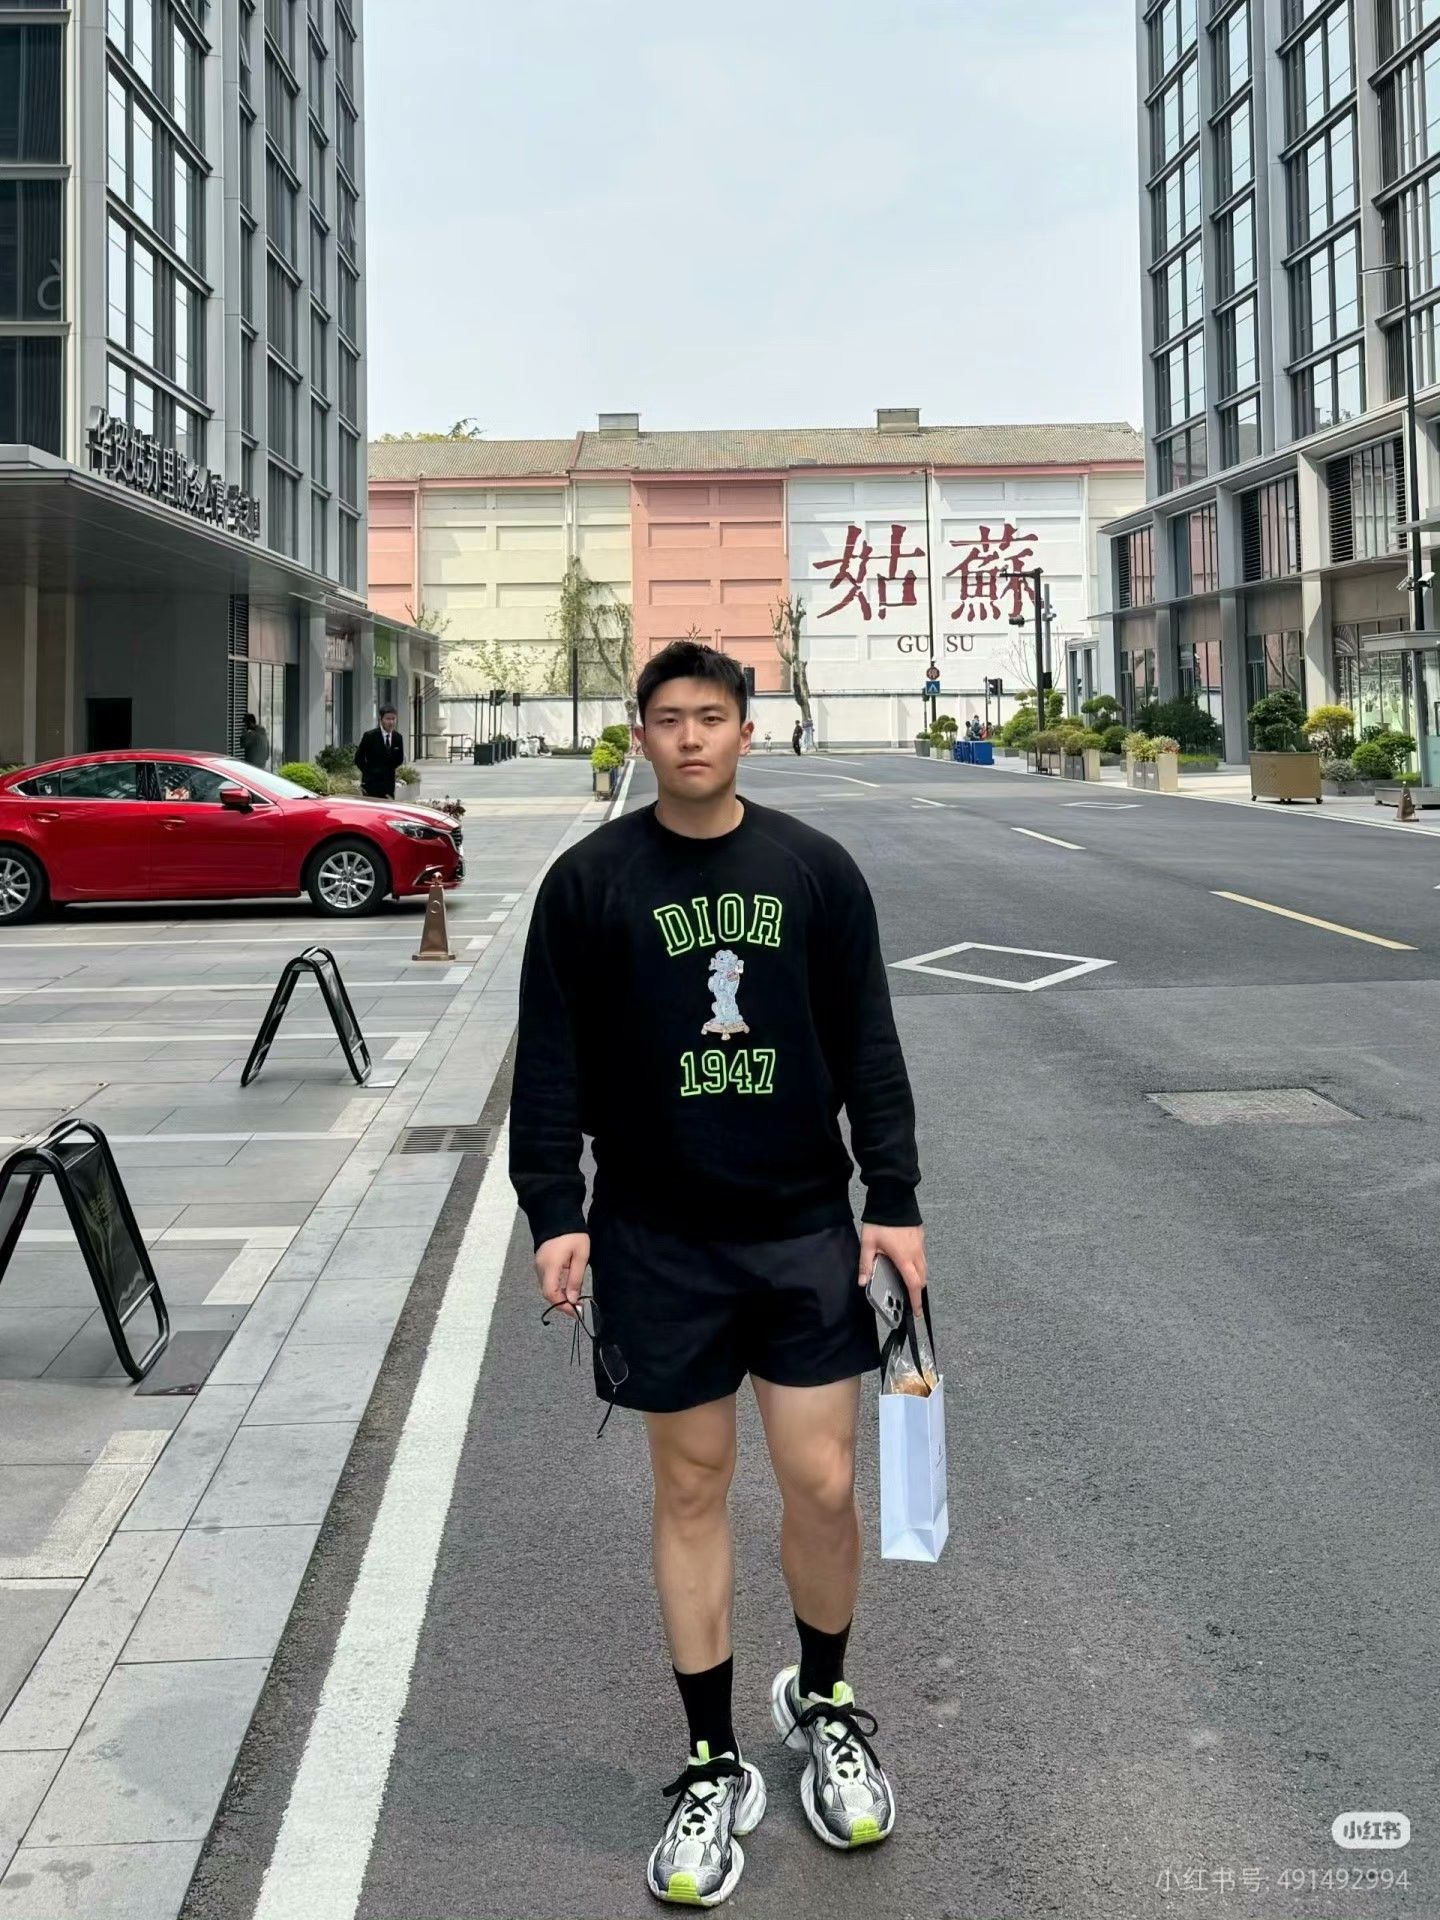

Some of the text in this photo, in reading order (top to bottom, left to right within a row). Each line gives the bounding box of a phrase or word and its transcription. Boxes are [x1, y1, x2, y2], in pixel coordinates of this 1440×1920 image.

[897, 634, 975, 653] GU SU
[653, 893, 783, 957] DIOR
[680, 1049, 776, 1096] 1947
